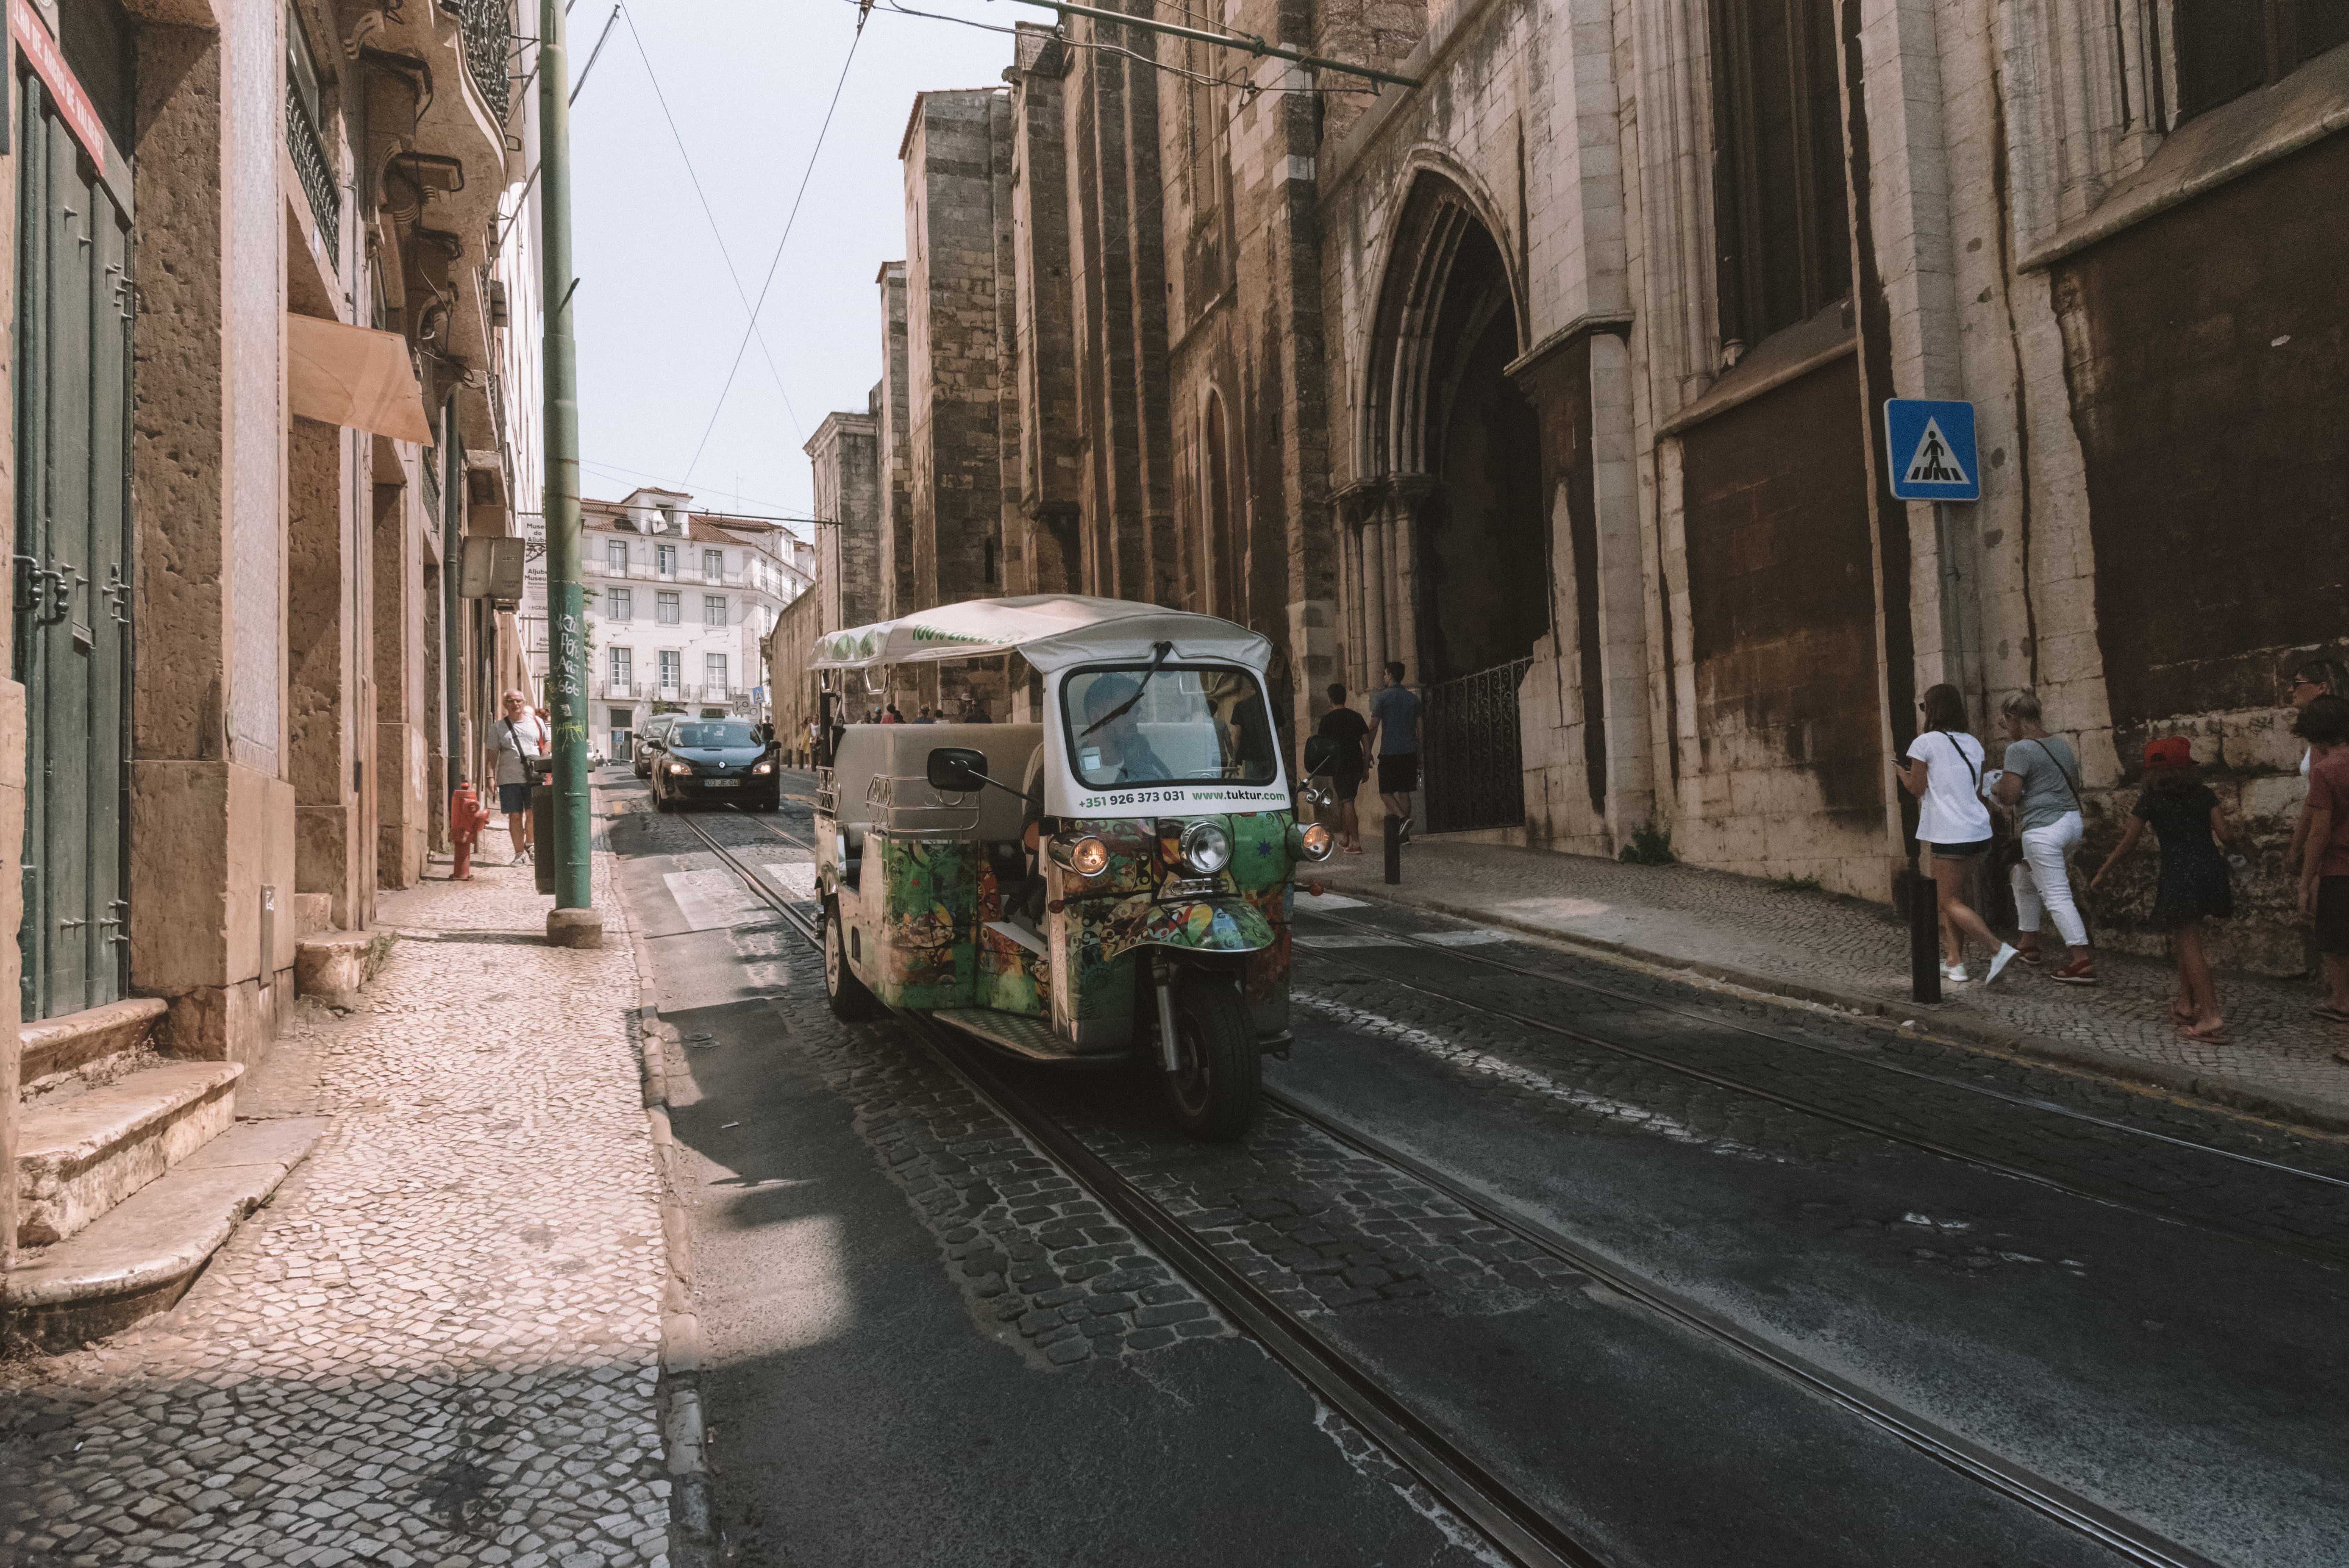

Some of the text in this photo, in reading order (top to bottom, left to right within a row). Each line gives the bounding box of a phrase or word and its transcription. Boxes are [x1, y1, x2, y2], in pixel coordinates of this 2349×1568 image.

[913, 625, 946, 641] 100%
[1079, 790, 1286, 808] +351 926 373 031 www.tuktur.com
